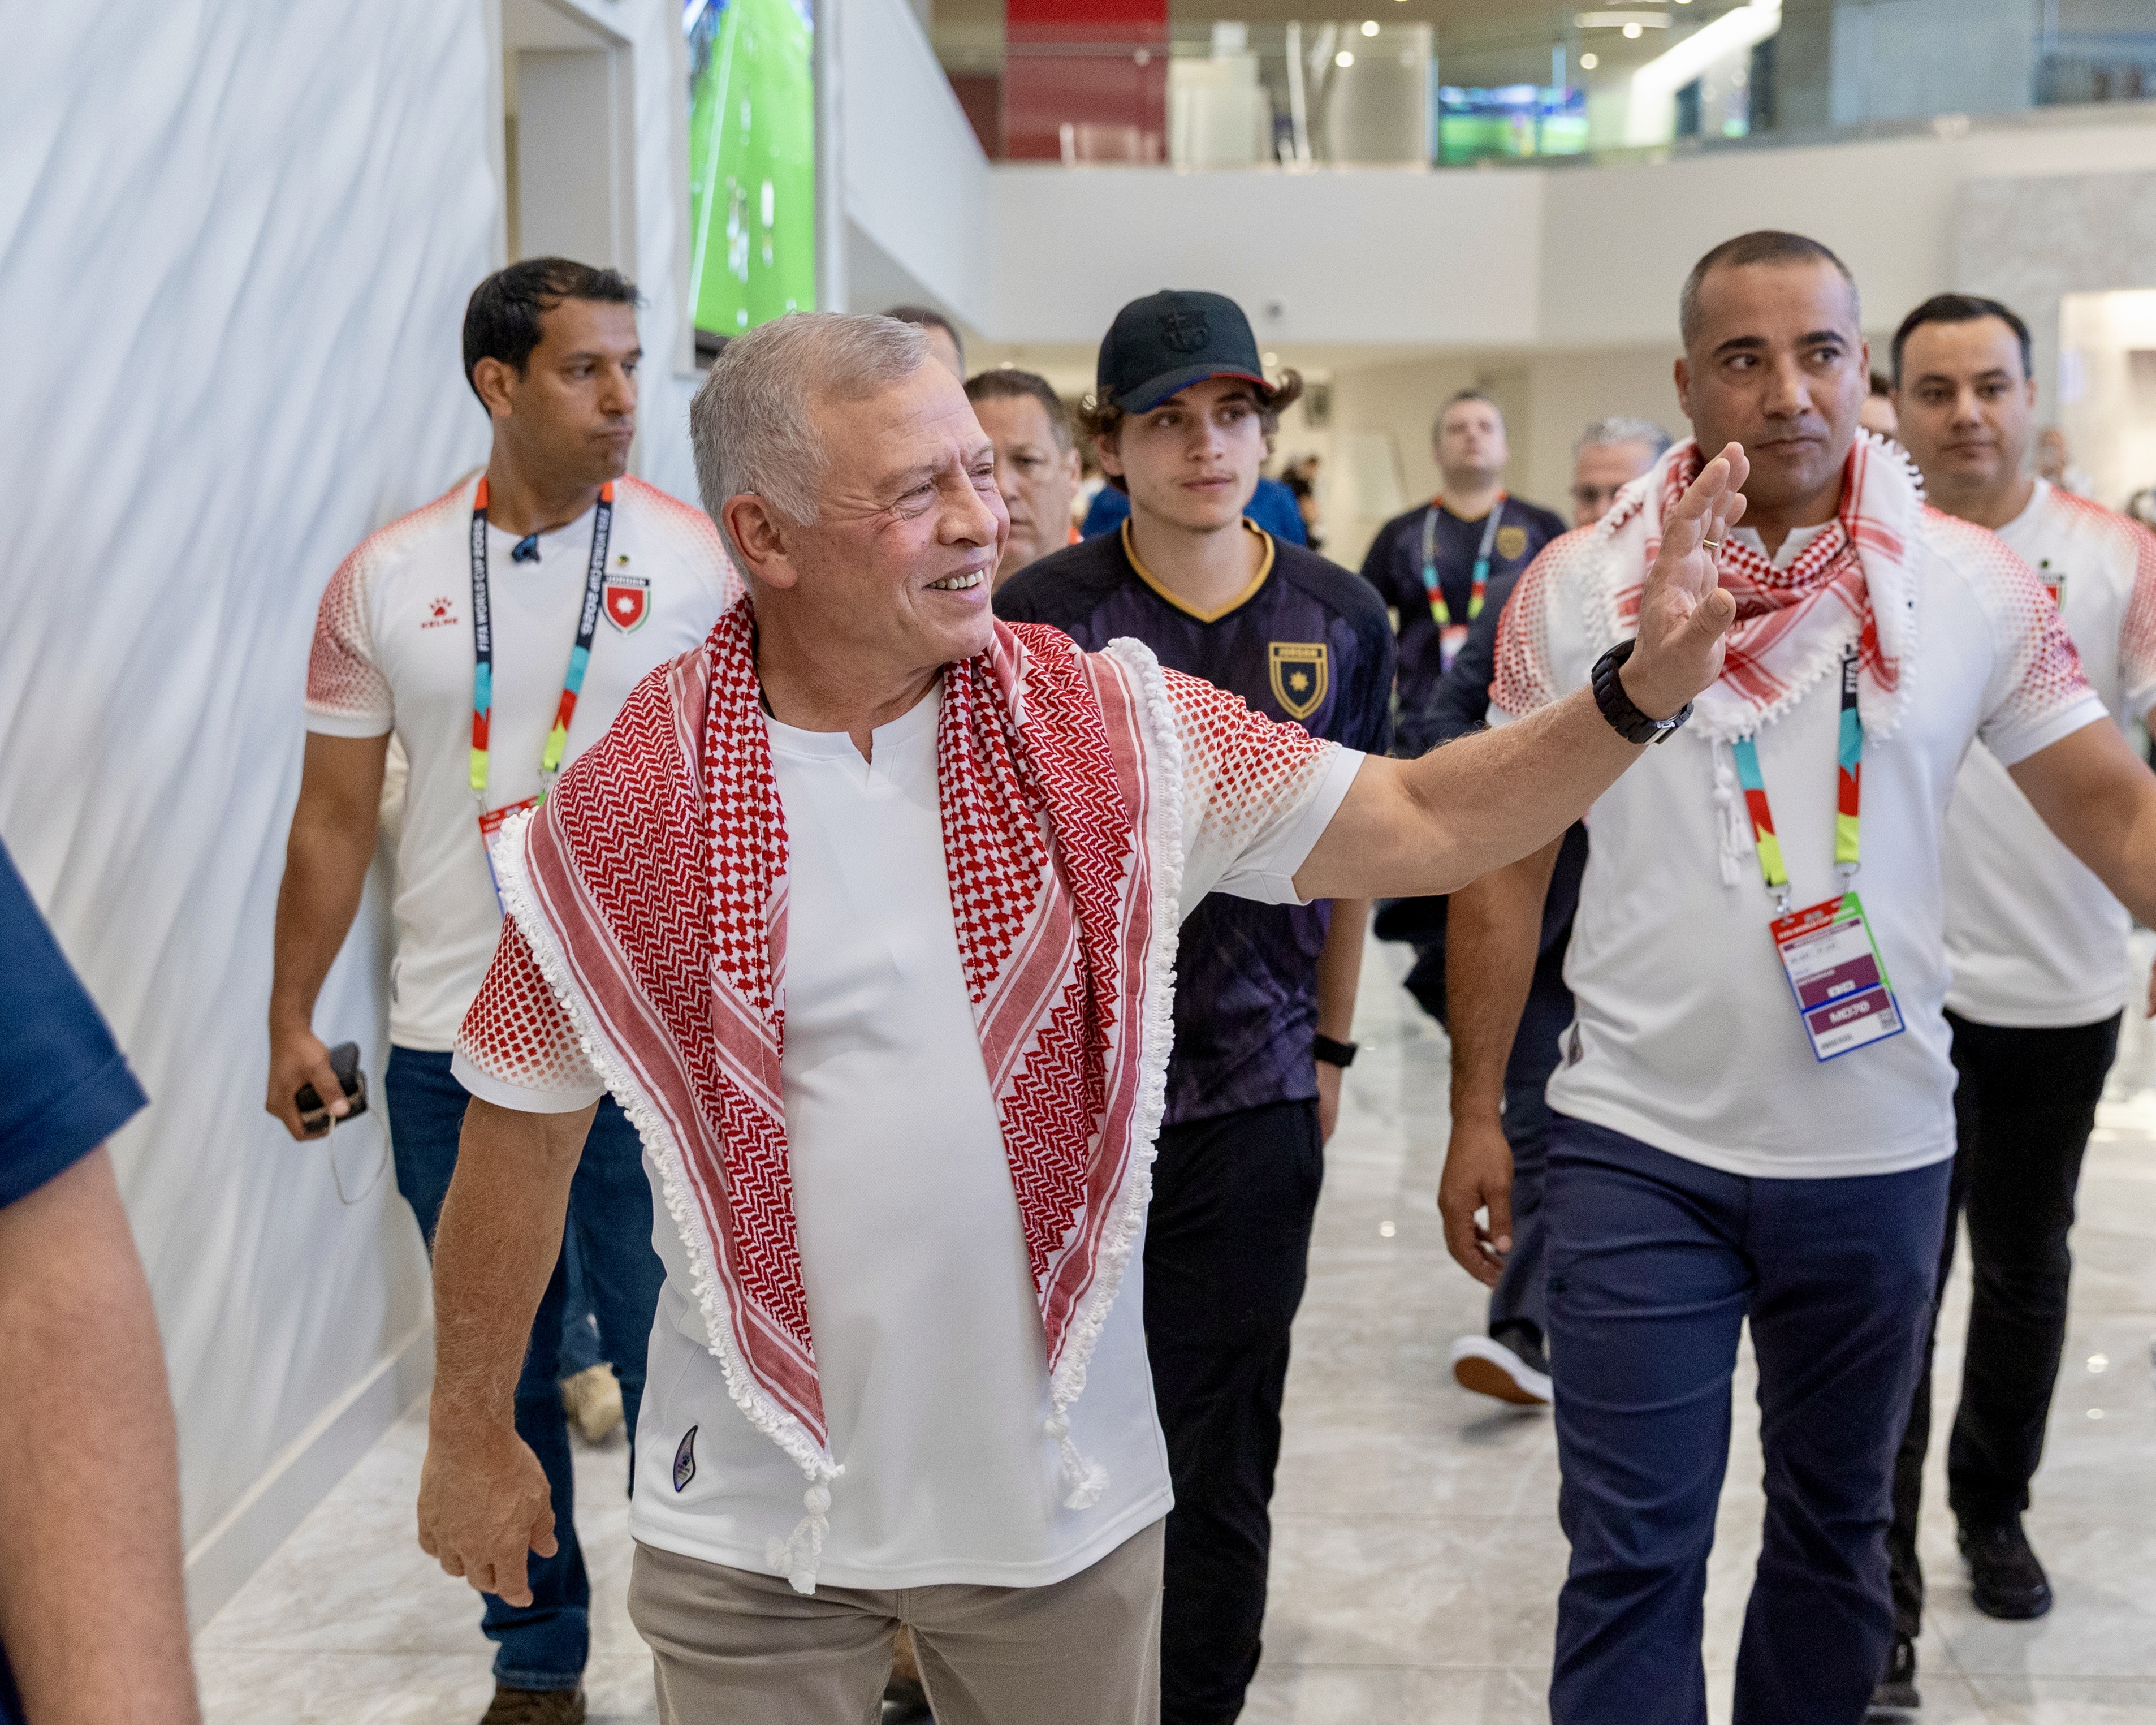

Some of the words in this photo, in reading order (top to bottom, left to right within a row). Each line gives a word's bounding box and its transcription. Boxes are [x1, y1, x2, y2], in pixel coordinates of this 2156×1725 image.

[472, 519, 485, 558] 2026
[591, 531, 608, 567] WORLD
[473, 558, 486, 581] CUP
[474, 581, 489, 624] WORLD
[580, 590, 599, 635] 2026
[477, 624, 490, 652] FIFA
